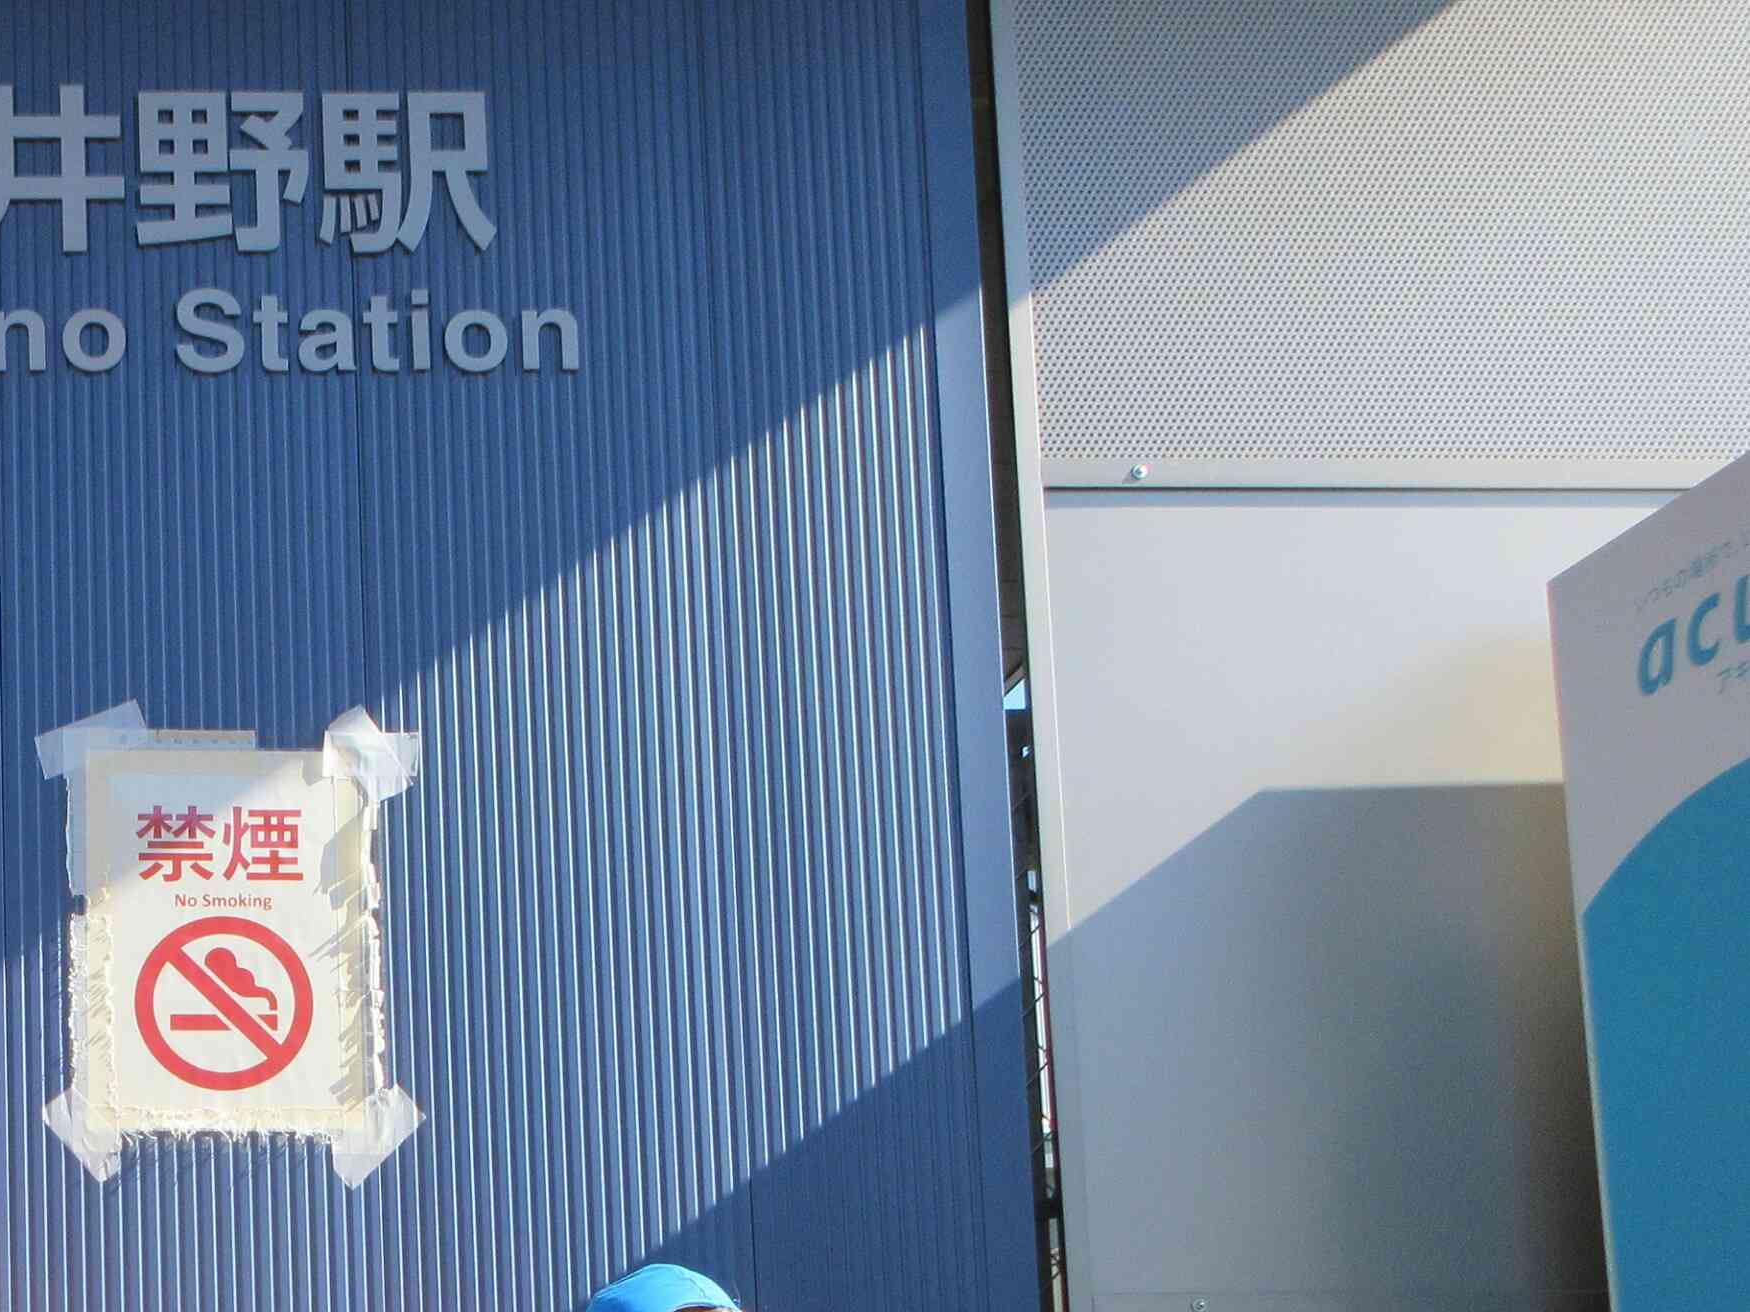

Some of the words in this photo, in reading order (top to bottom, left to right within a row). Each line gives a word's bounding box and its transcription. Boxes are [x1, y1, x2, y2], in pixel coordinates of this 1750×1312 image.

[175, 286, 580, 376] Station
[135, 805, 304, 882] 禁煙
[175, 894, 198, 908] No
[202, 893, 273, 912] Smoking
